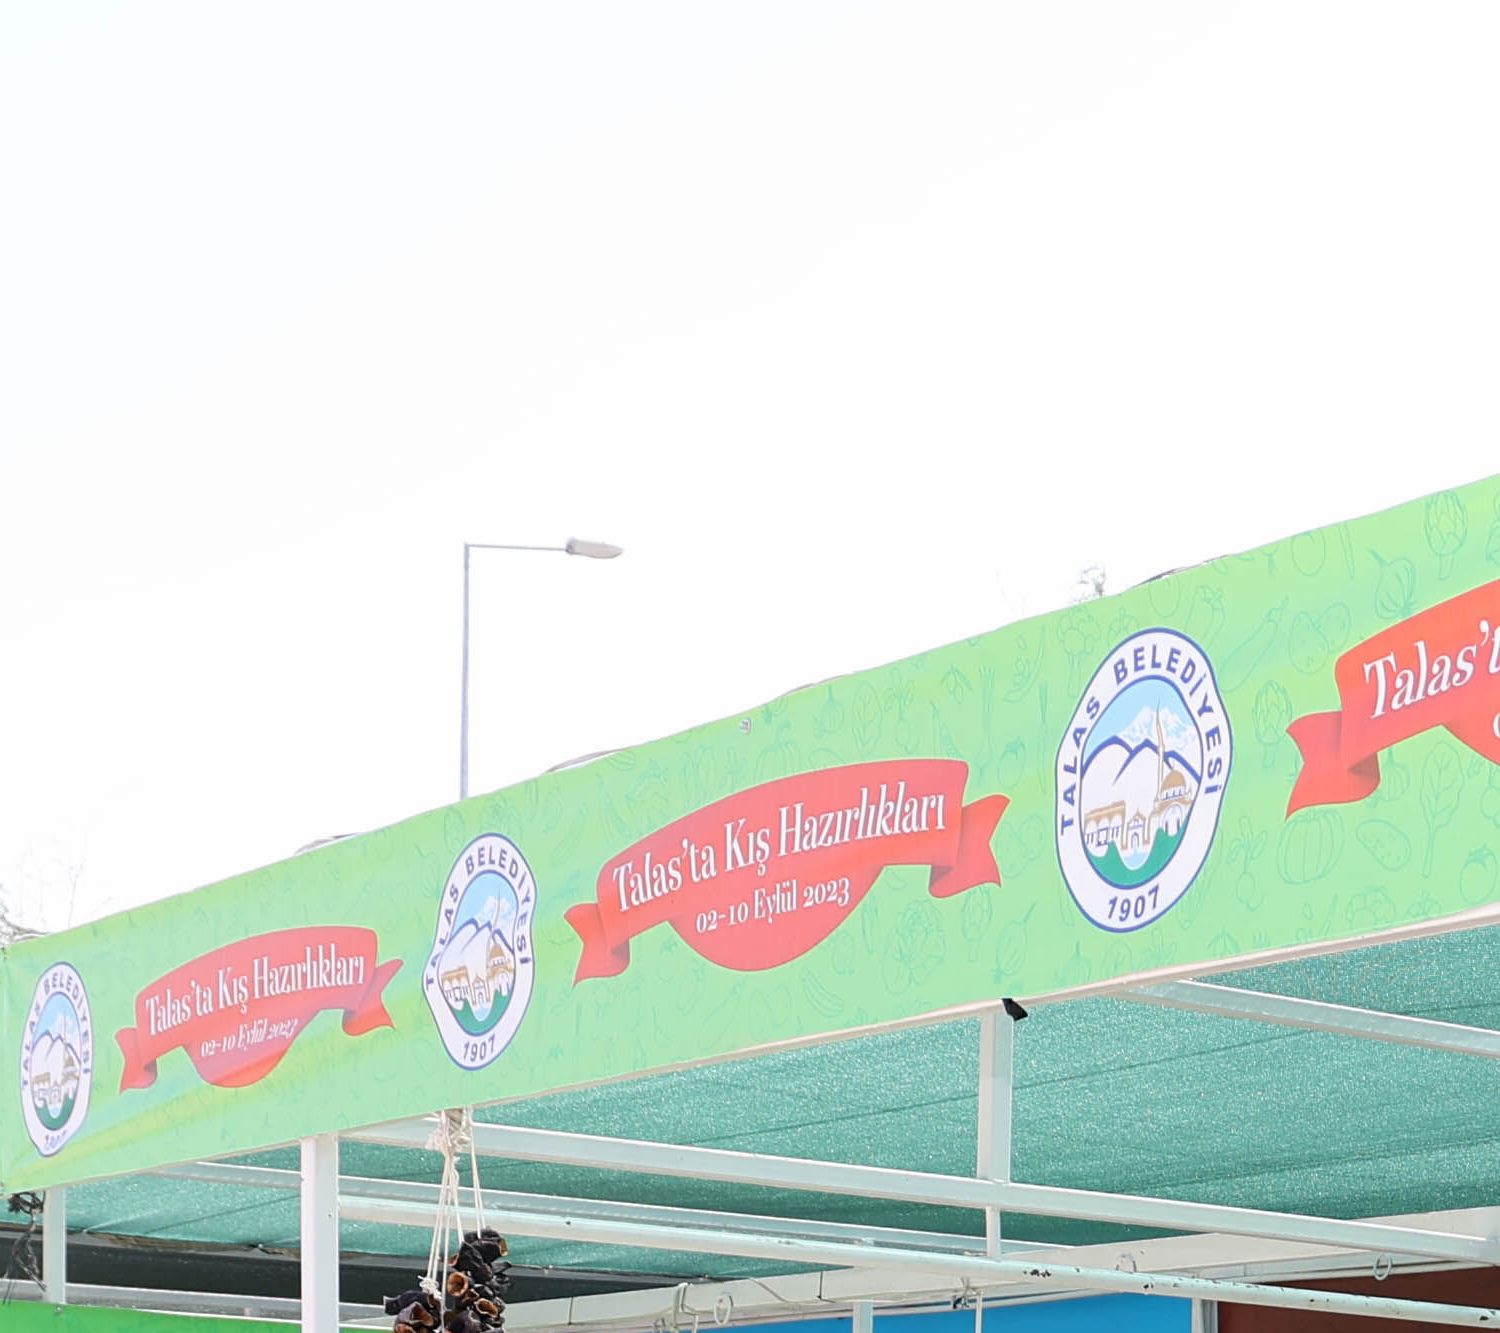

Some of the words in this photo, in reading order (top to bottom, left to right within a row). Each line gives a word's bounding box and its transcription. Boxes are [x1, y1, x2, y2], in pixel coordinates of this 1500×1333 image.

[1060, 692, 1102, 835] TALAS
[1112, 643, 1226, 796] BELEDİYESİ
[611, 839, 719, 914] Talas'ta
[722, 816, 771, 877] Kış
[778, 780, 947, 858] Hazırlıkları
[424, 880, 463, 991] TALAS
[464, 845, 534, 968] BELEDİYESİ
[695, 900, 749, 935] 02-10
[752, 882, 798, 926] Eylül
[802, 875, 851, 911] 2023
[1106, 884, 1162, 924] 1907
[145, 979, 213, 1036] Talas'ta
[217, 966, 248, 1015] Kış
[252, 943, 365, 1000] Hazırlıkları
[201, 1033, 236, 1057] 02-10
[237, 1017, 268, 1051] Eylül
[268, 1017, 300, 1041] 2023
[461, 1033, 498, 1064] 1907
